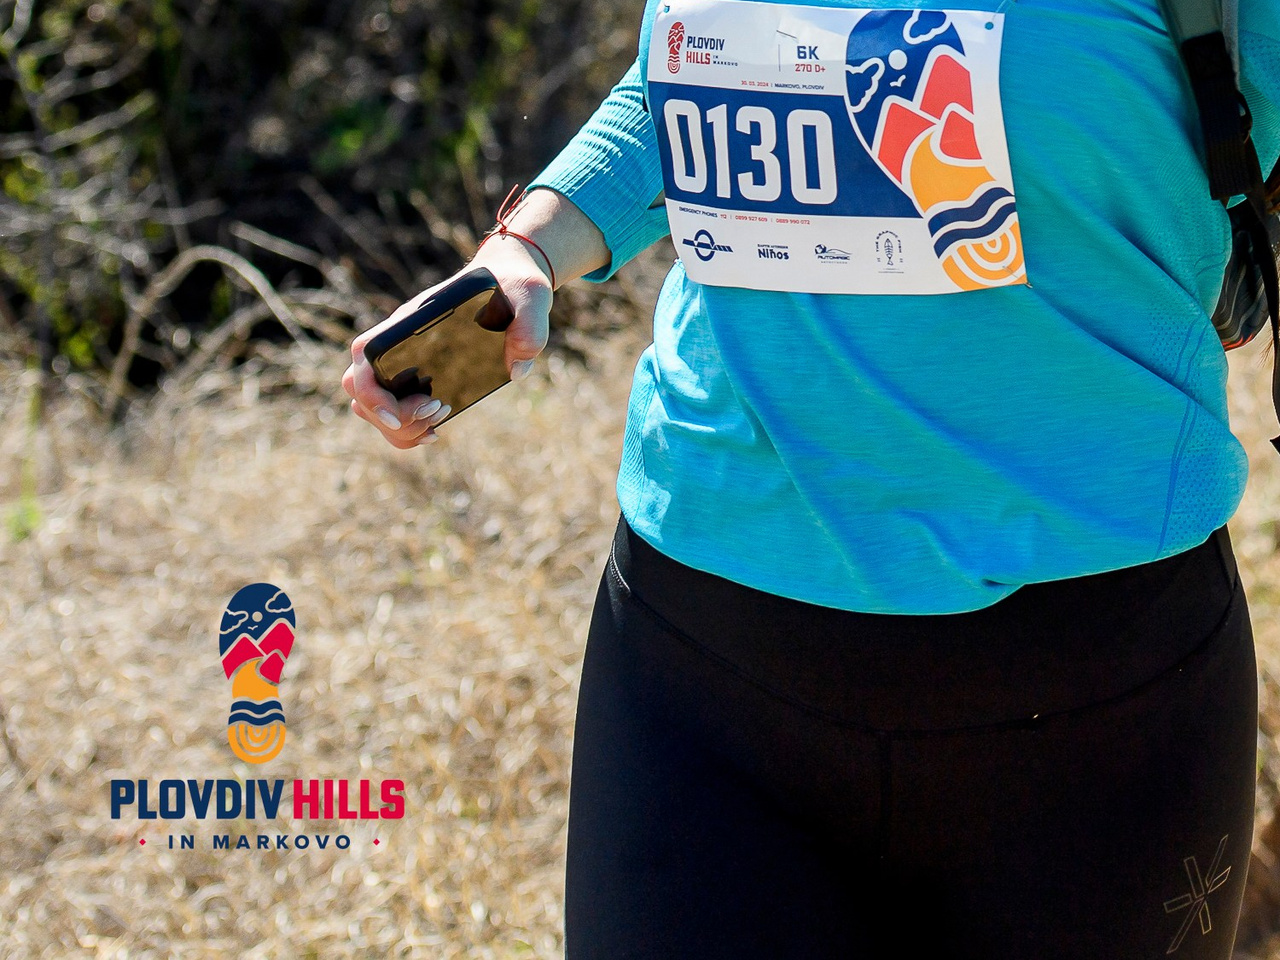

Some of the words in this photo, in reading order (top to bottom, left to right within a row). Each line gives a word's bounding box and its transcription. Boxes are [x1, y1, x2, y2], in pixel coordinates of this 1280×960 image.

[686, 35, 725, 51] PLOVDIV
[685, 51, 711, 65] HILLS
[796, 45, 819, 60] 6K
[795, 64, 812, 73] 270
[814, 65, 826, 73] D+
[663, 98, 838, 205] 0130
[678, 206, 702, 215] EMERGENCY
